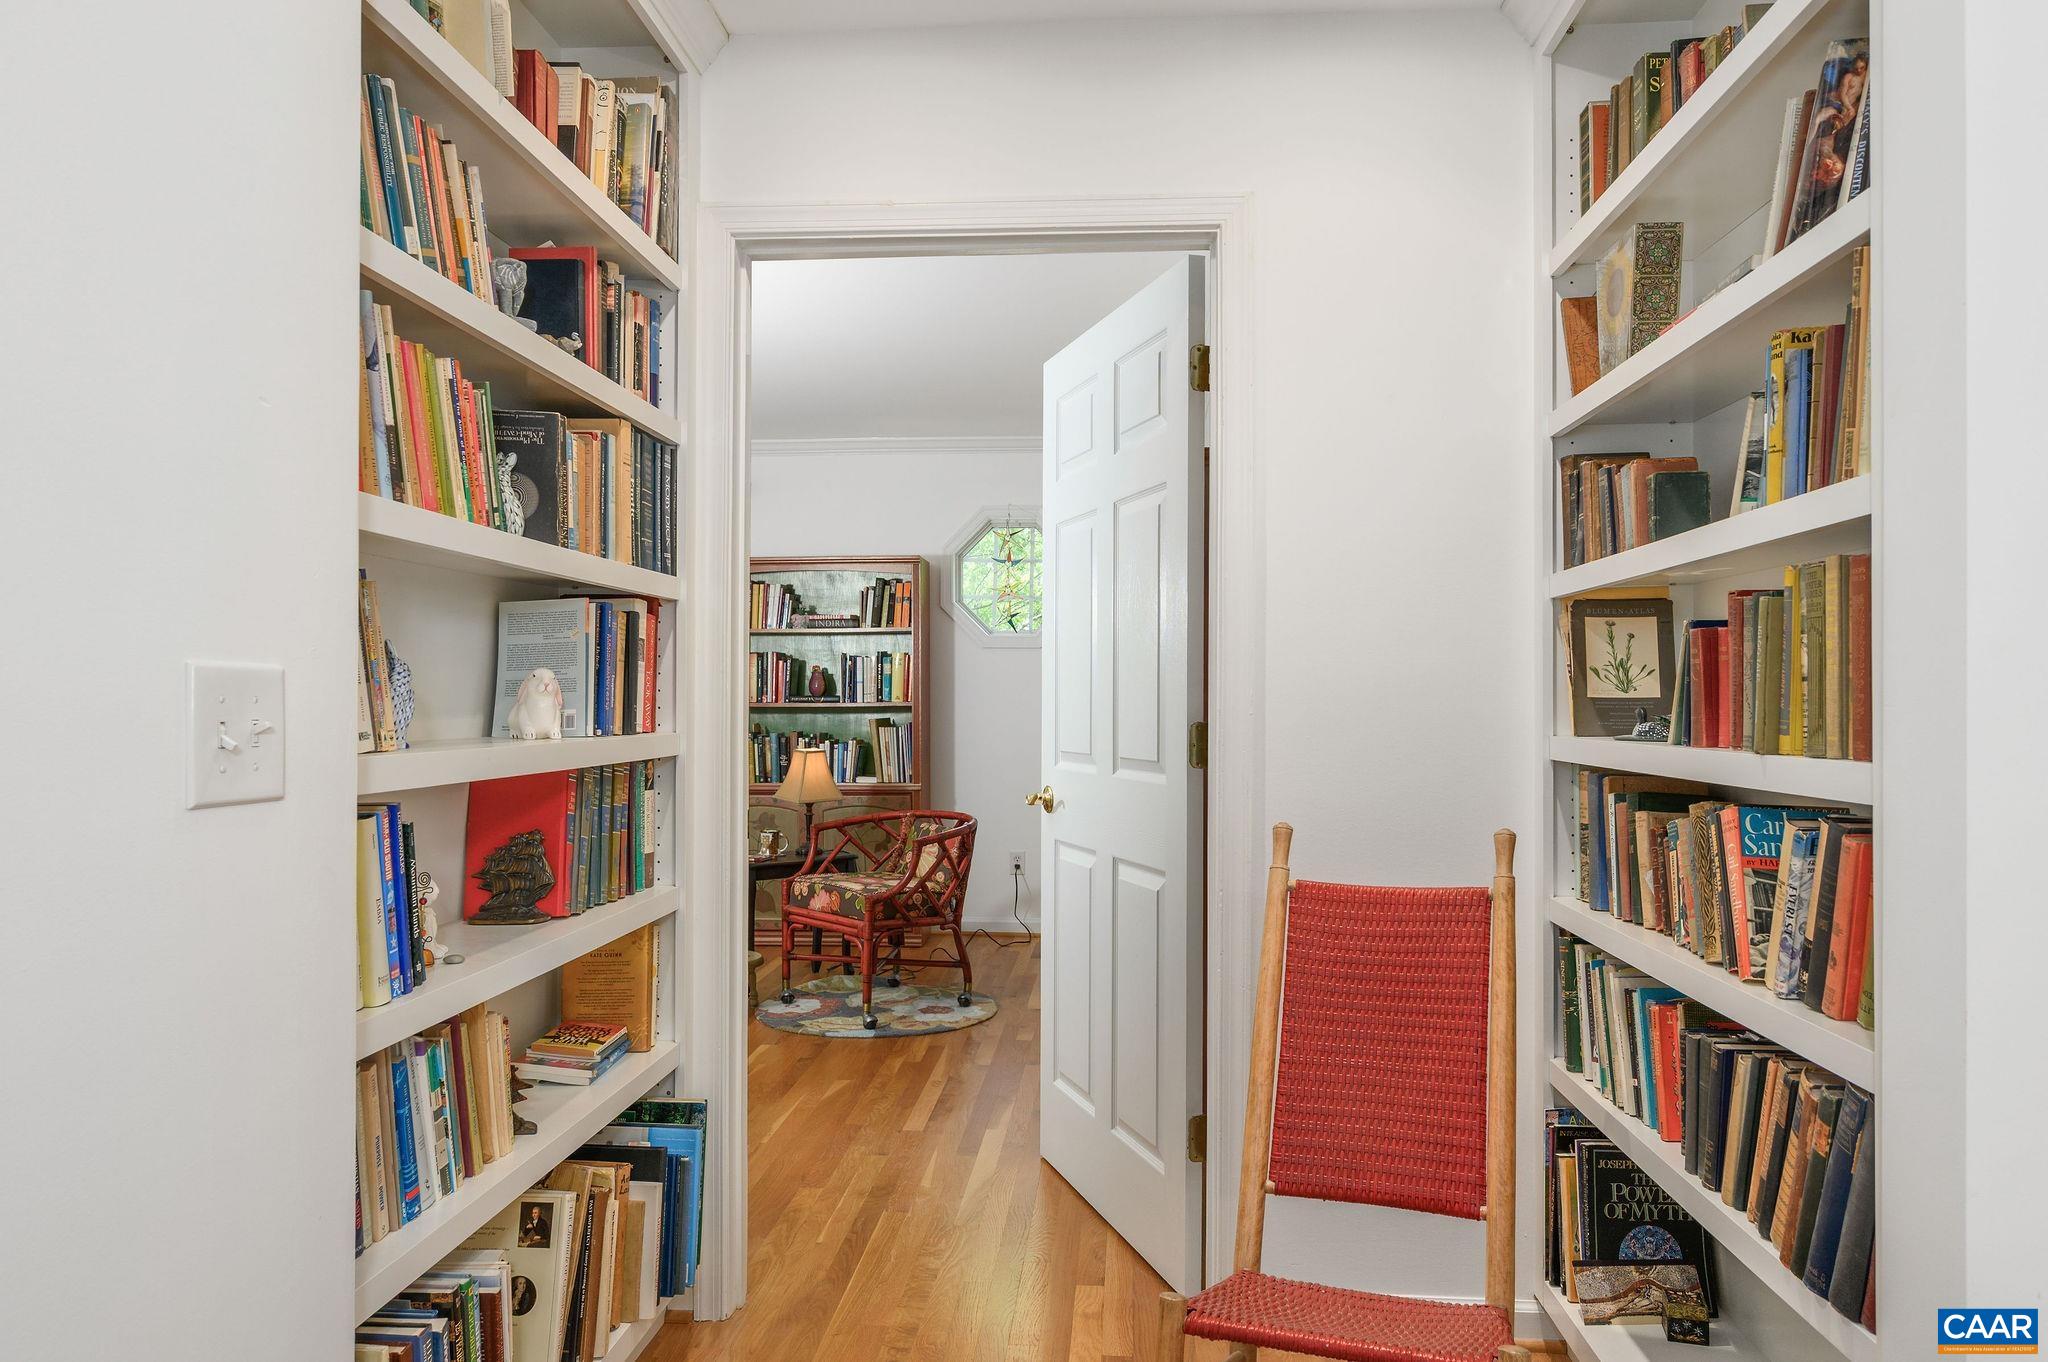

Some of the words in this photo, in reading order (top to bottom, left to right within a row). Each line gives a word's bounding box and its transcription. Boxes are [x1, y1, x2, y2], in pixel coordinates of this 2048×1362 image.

[376, 108, 385, 131] PUBLIC
[1791, 330, 1815, 344] Ka
[460, 450, 470, 487] Education
[384, 854, 393, 881] SOUTH
[1725, 842, 1738, 868] Carl
[408, 858, 418, 907] Mountain
[1728, 873, 1744, 936] Sandburg
[1784, 883, 1799, 938] EVEREST
[411, 908, 420, 938] Hands
[373, 1135, 383, 1167] PURPOSE
[1597, 1159, 1638, 1170] JOSEPH
[377, 1185, 386, 1211] POWER
[1604, 1203, 1629, 1219] OF
[565, 1225, 573, 1264] Chronicle
